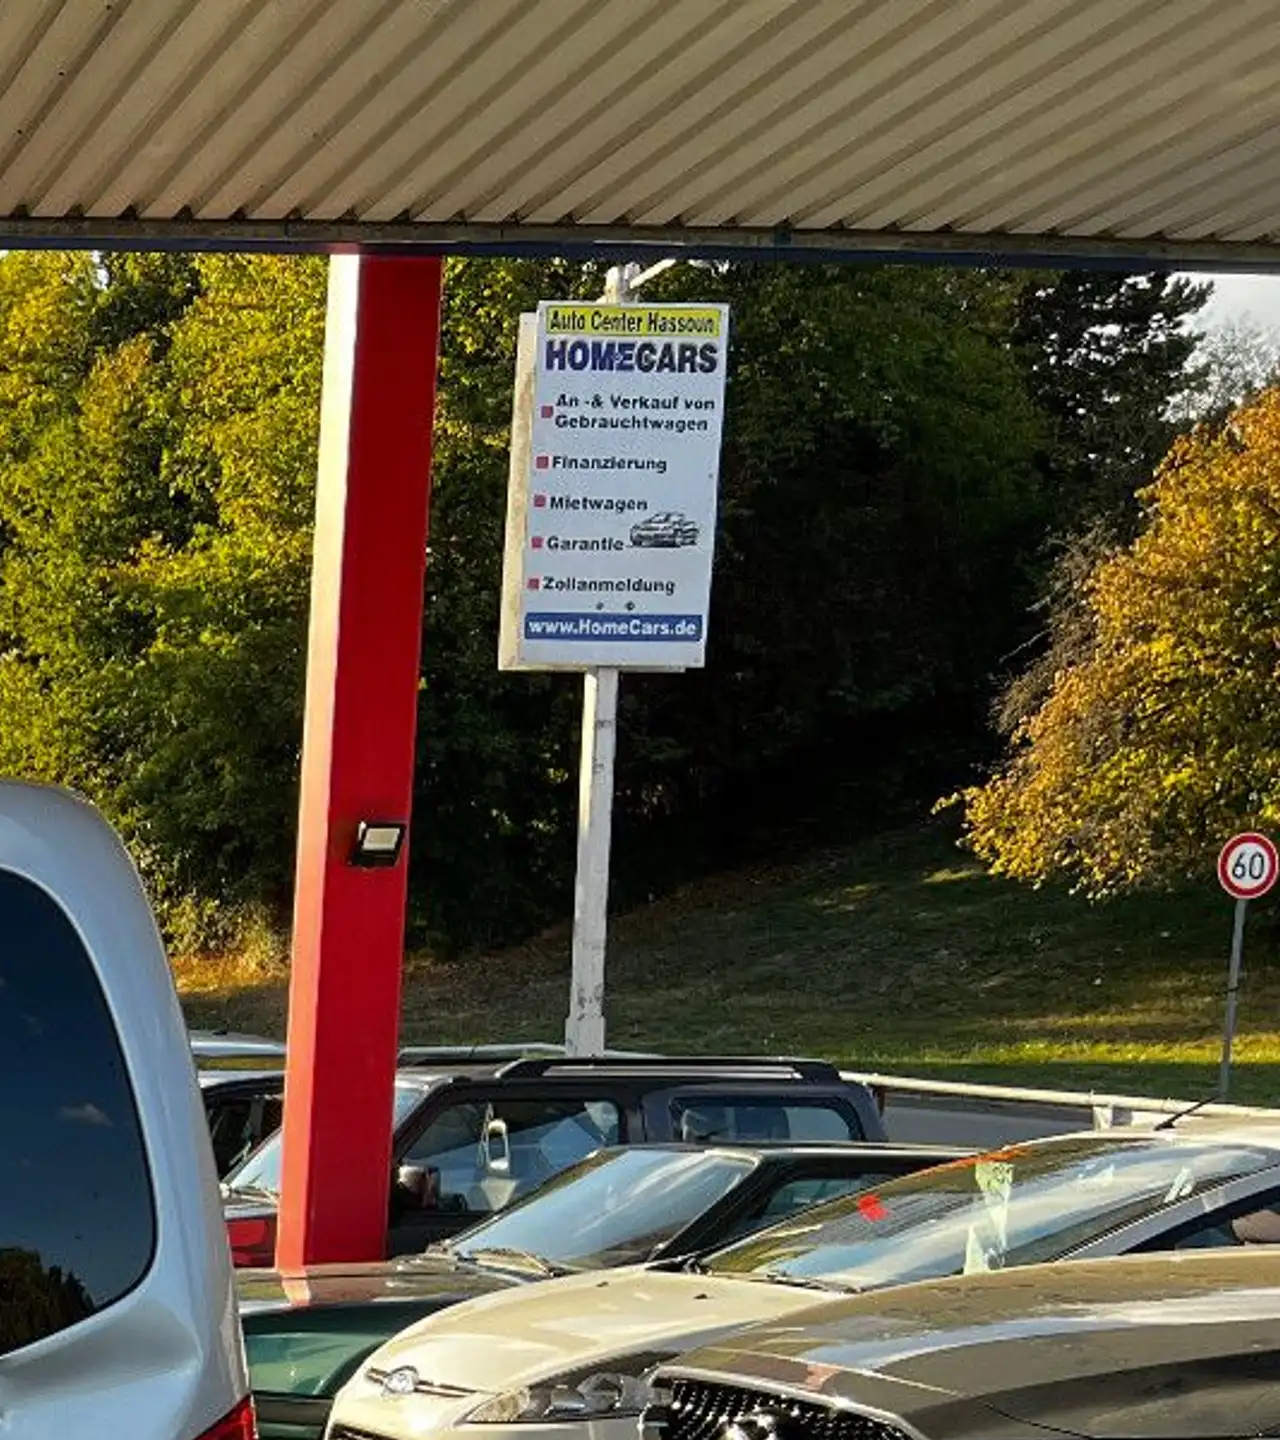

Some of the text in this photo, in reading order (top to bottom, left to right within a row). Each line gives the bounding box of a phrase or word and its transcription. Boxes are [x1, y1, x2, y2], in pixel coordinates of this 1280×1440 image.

[550, 311, 715, 334] Auto Center Hassoun
[545, 340, 717, 374] HOMECARS
[556, 394, 579, 409] An
[610, 394, 680, 410] Verkauf
[685, 398, 715, 411] von
[555, 414, 708, 433] Gebrauchtwagen
[552, 455, 667, 474] Finanzierung
[549, 495, 648, 513] Mietwagen
[547, 535, 625, 551] Garantie
[543, 576, 676, 596] Zollanmeldung
[528, 618, 697, 636] www.HomeCars.de
[1232, 851, 1265, 880] 60
